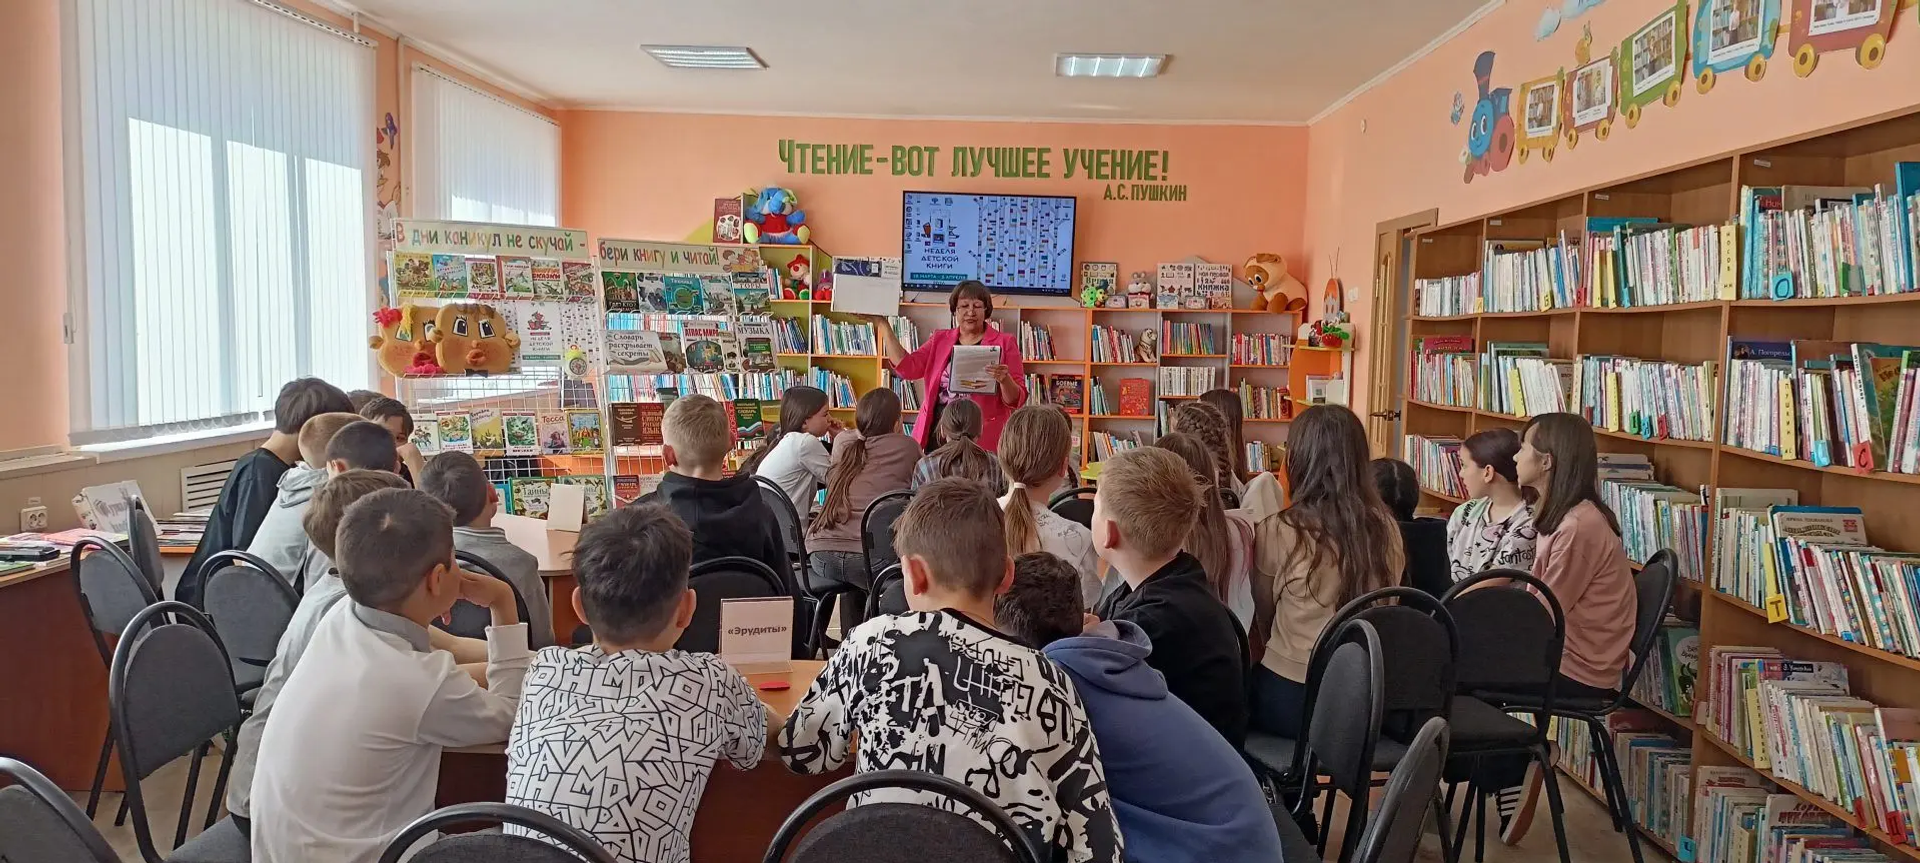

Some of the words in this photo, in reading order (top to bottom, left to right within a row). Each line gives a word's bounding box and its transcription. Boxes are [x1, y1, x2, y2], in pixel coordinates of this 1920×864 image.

[951, 146, 1052, 178] ЛУЧШЕЕ
[1063, 148, 1170, 181] УЧЕНИЕ!
[1131, 184, 1187, 202] ПУШКИН
[396, 223, 406, 243] В
[412, 229, 438, 246] дни
[445, 230, 502, 252] каникул
[507, 232, 523, 249] не
[529, 231, 574, 256] скучай
[600, 242, 629, 266] бери
[634, 248, 666, 268] книгу
[670, 251, 679, 264] и
[683, 246, 720, 266] читай!
[921, 254, 959, 262] ДЕТСКОЙ
[926, 262, 953, 270] КНИГИ
[738, 326, 770, 335] МУЗЫКА
[613, 333, 644, 344] Словарь
[608, 342, 654, 350] раскрывает
[618, 350, 649, 358] секреты
[1770, 601, 1782, 618] Т
[728, 626, 787, 636] «Эрудиты»
